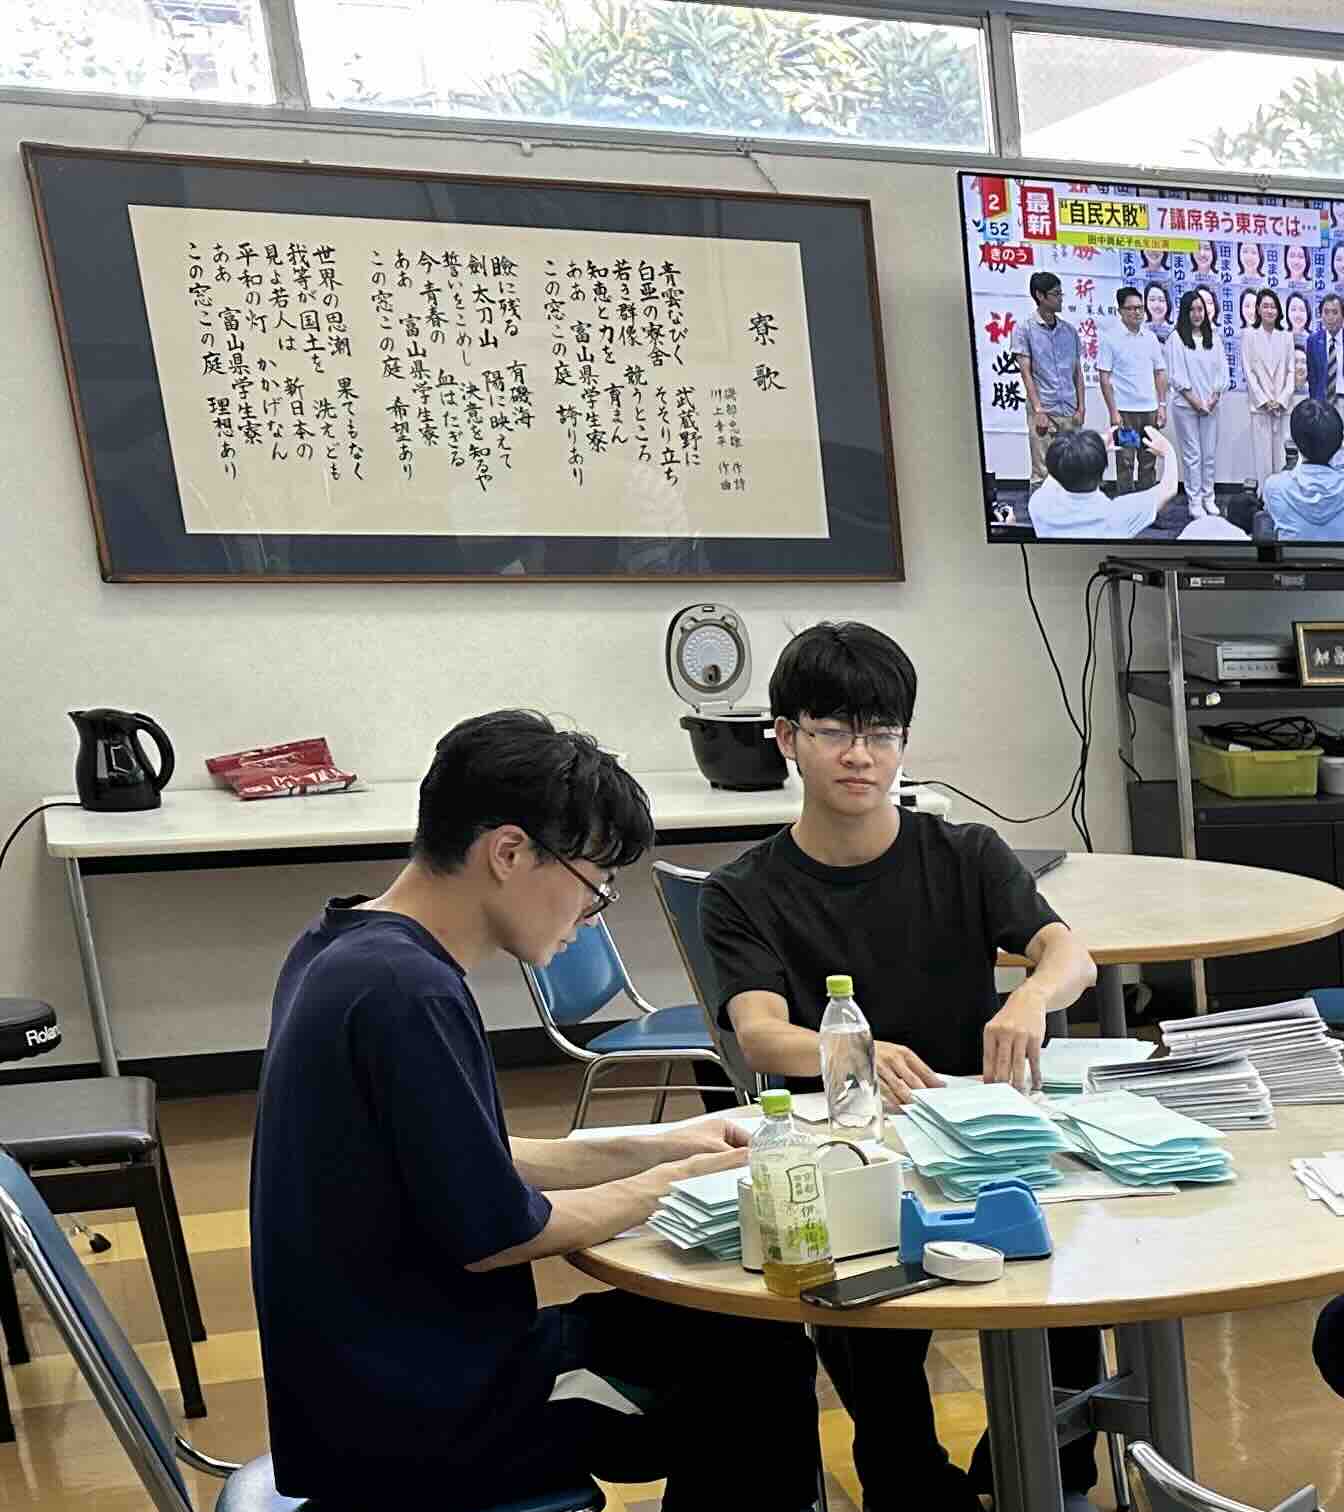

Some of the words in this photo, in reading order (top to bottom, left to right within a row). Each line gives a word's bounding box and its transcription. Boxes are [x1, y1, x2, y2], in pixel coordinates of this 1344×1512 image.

[987, 193, 1001, 211] 2
[990, 222, 1010, 236] 52
[1026, 192, 1051, 236] 最新
[212, 244, 232, 284] ああ
[394, 249, 414, 289] ああ
[566, 261, 586, 303] ああ
[612, 258, 643, 348] 若き群像
[990, 250, 1028, 263] きのう
[187, 241, 227, 377] この窓この庭
[207, 396, 238, 481] 理想あり
[235, 243, 269, 334] 平和の灯
[257, 357, 288, 461] かかげなん
[264, 243, 298, 352] 見よ若人は
[284, 376, 316, 460] 新日本の
[286, 243, 326, 374] 我等が国土を
[313, 398, 341, 481] 洗えども
[312, 244, 353, 358] 世界の思潮
[337, 377, 365, 481] 果てもなく
[369, 250, 407, 380] この窓この庭
[416, 250, 449, 345] 今青春の
[434, 368, 466, 468] 血はたぎる
[544, 259, 577, 387] この窓この庭
[586, 260, 617, 365] 知恵と力を
[604, 383, 628, 445] 育まん
[218, 306, 264, 446] 富山県学生寮
[399, 313, 441, 447] 富山県学生寮
[481, 370, 514, 470] 陽に映えて
[570, 320, 609, 454] 富山県学生寮
[623, 364, 652, 463] 競うところ
[675, 386, 703, 467] 武蔵野に
[386, 396, 414, 481] 希望あり
[460, 382, 494, 492] 決意を知るや
[556, 404, 585, 488] 誇りあり
[656, 386, 682, 487] そそり立ち
